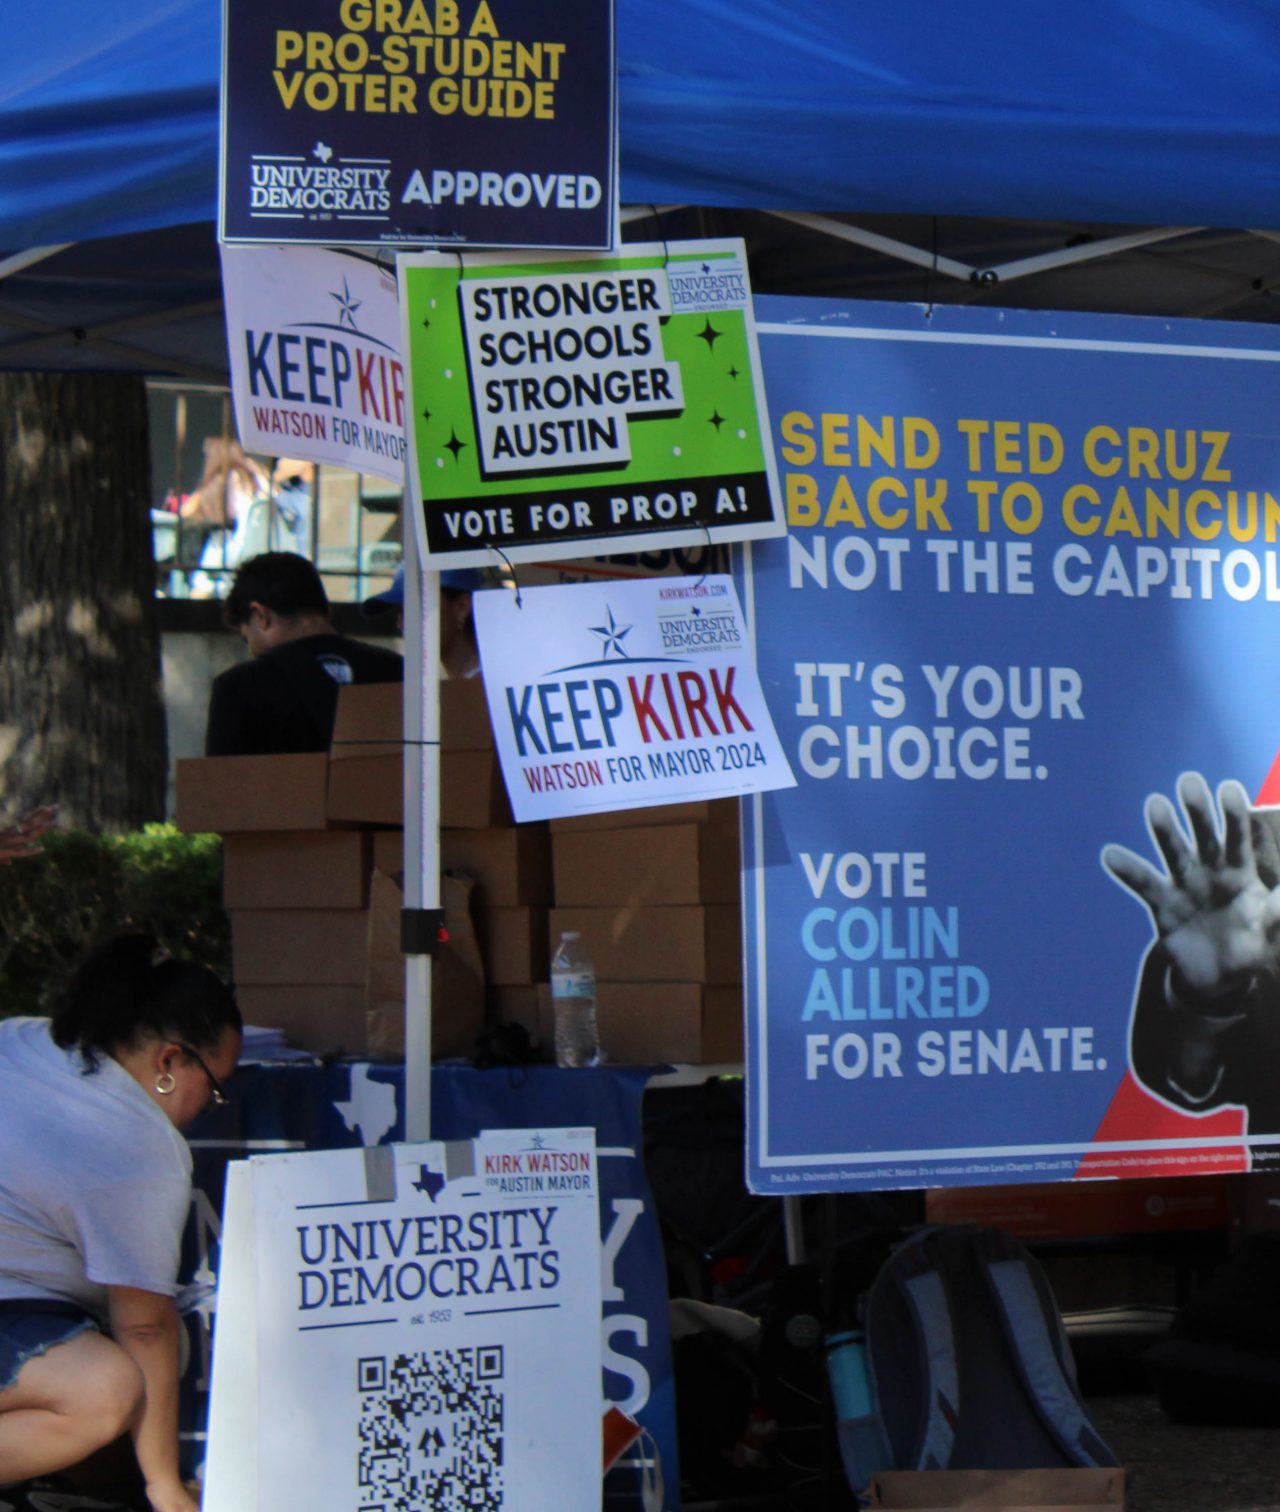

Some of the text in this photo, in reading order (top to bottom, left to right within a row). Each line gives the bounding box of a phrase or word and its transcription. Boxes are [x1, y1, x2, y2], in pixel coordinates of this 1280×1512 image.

[339, 0, 500, 38] GRAB A
[275, 30, 566, 81] PRO-STUDENT
[273, 70, 555, 119] VOTER GUIDE
[251, 186, 391, 211] DEMOCRATS
[252, 164, 391, 190] UNIVERSITY
[401, 170, 602, 209] APPROVED
[473, 276, 661, 322] STRONGER
[671, 274, 743, 291] UNIVERSITY
[672, 287, 746, 305] DEMOCRATS
[480, 321, 652, 368] SCHOOLS
[245, 329, 404, 427] KEEP KIR
[486, 367, 674, 414] STRONGER
[252, 405, 327, 440] WATSON
[332, 417, 360, 447] FOR
[492, 416, 620, 460] AUSTIN
[781, 411, 1232, 482] SEND TED CRUZ
[445, 486, 749, 538] VOTE FOR PROP A!
[786, 473, 950, 532] BACK
[967, 480, 1043, 534] TO
[787, 535, 909, 591] NOT
[926, 540, 1034, 594] THE
[659, 585, 728, 601] KIRKWATSON.COM
[660, 616, 736, 636] UNIVERSITY
[662, 630, 740, 648] DEMOCRATS
[506, 666, 755, 757] KEEP KIRK
[794, 661, 1085, 720] IT'S YOUR
[522, 744, 768, 794] WATSON FOR MAYOR 2024
[799, 725, 1048, 779] CHOICE.
[800, 852, 927, 899] VOTE
[802, 906, 959, 962] COLIN
[801, 966, 989, 1021] ALLRED
[806, 1027, 1108, 1080] FOR SENATE.
[485, 1152, 590, 1174] KIRK WATSON
[499, 1176, 543, 1192] AUSTIN
[548, 1174, 591, 1191] MAYOR
[297, 1206, 559, 1265] UNIVERSITY
[298, 1251, 561, 1310] DEMOCRATS
